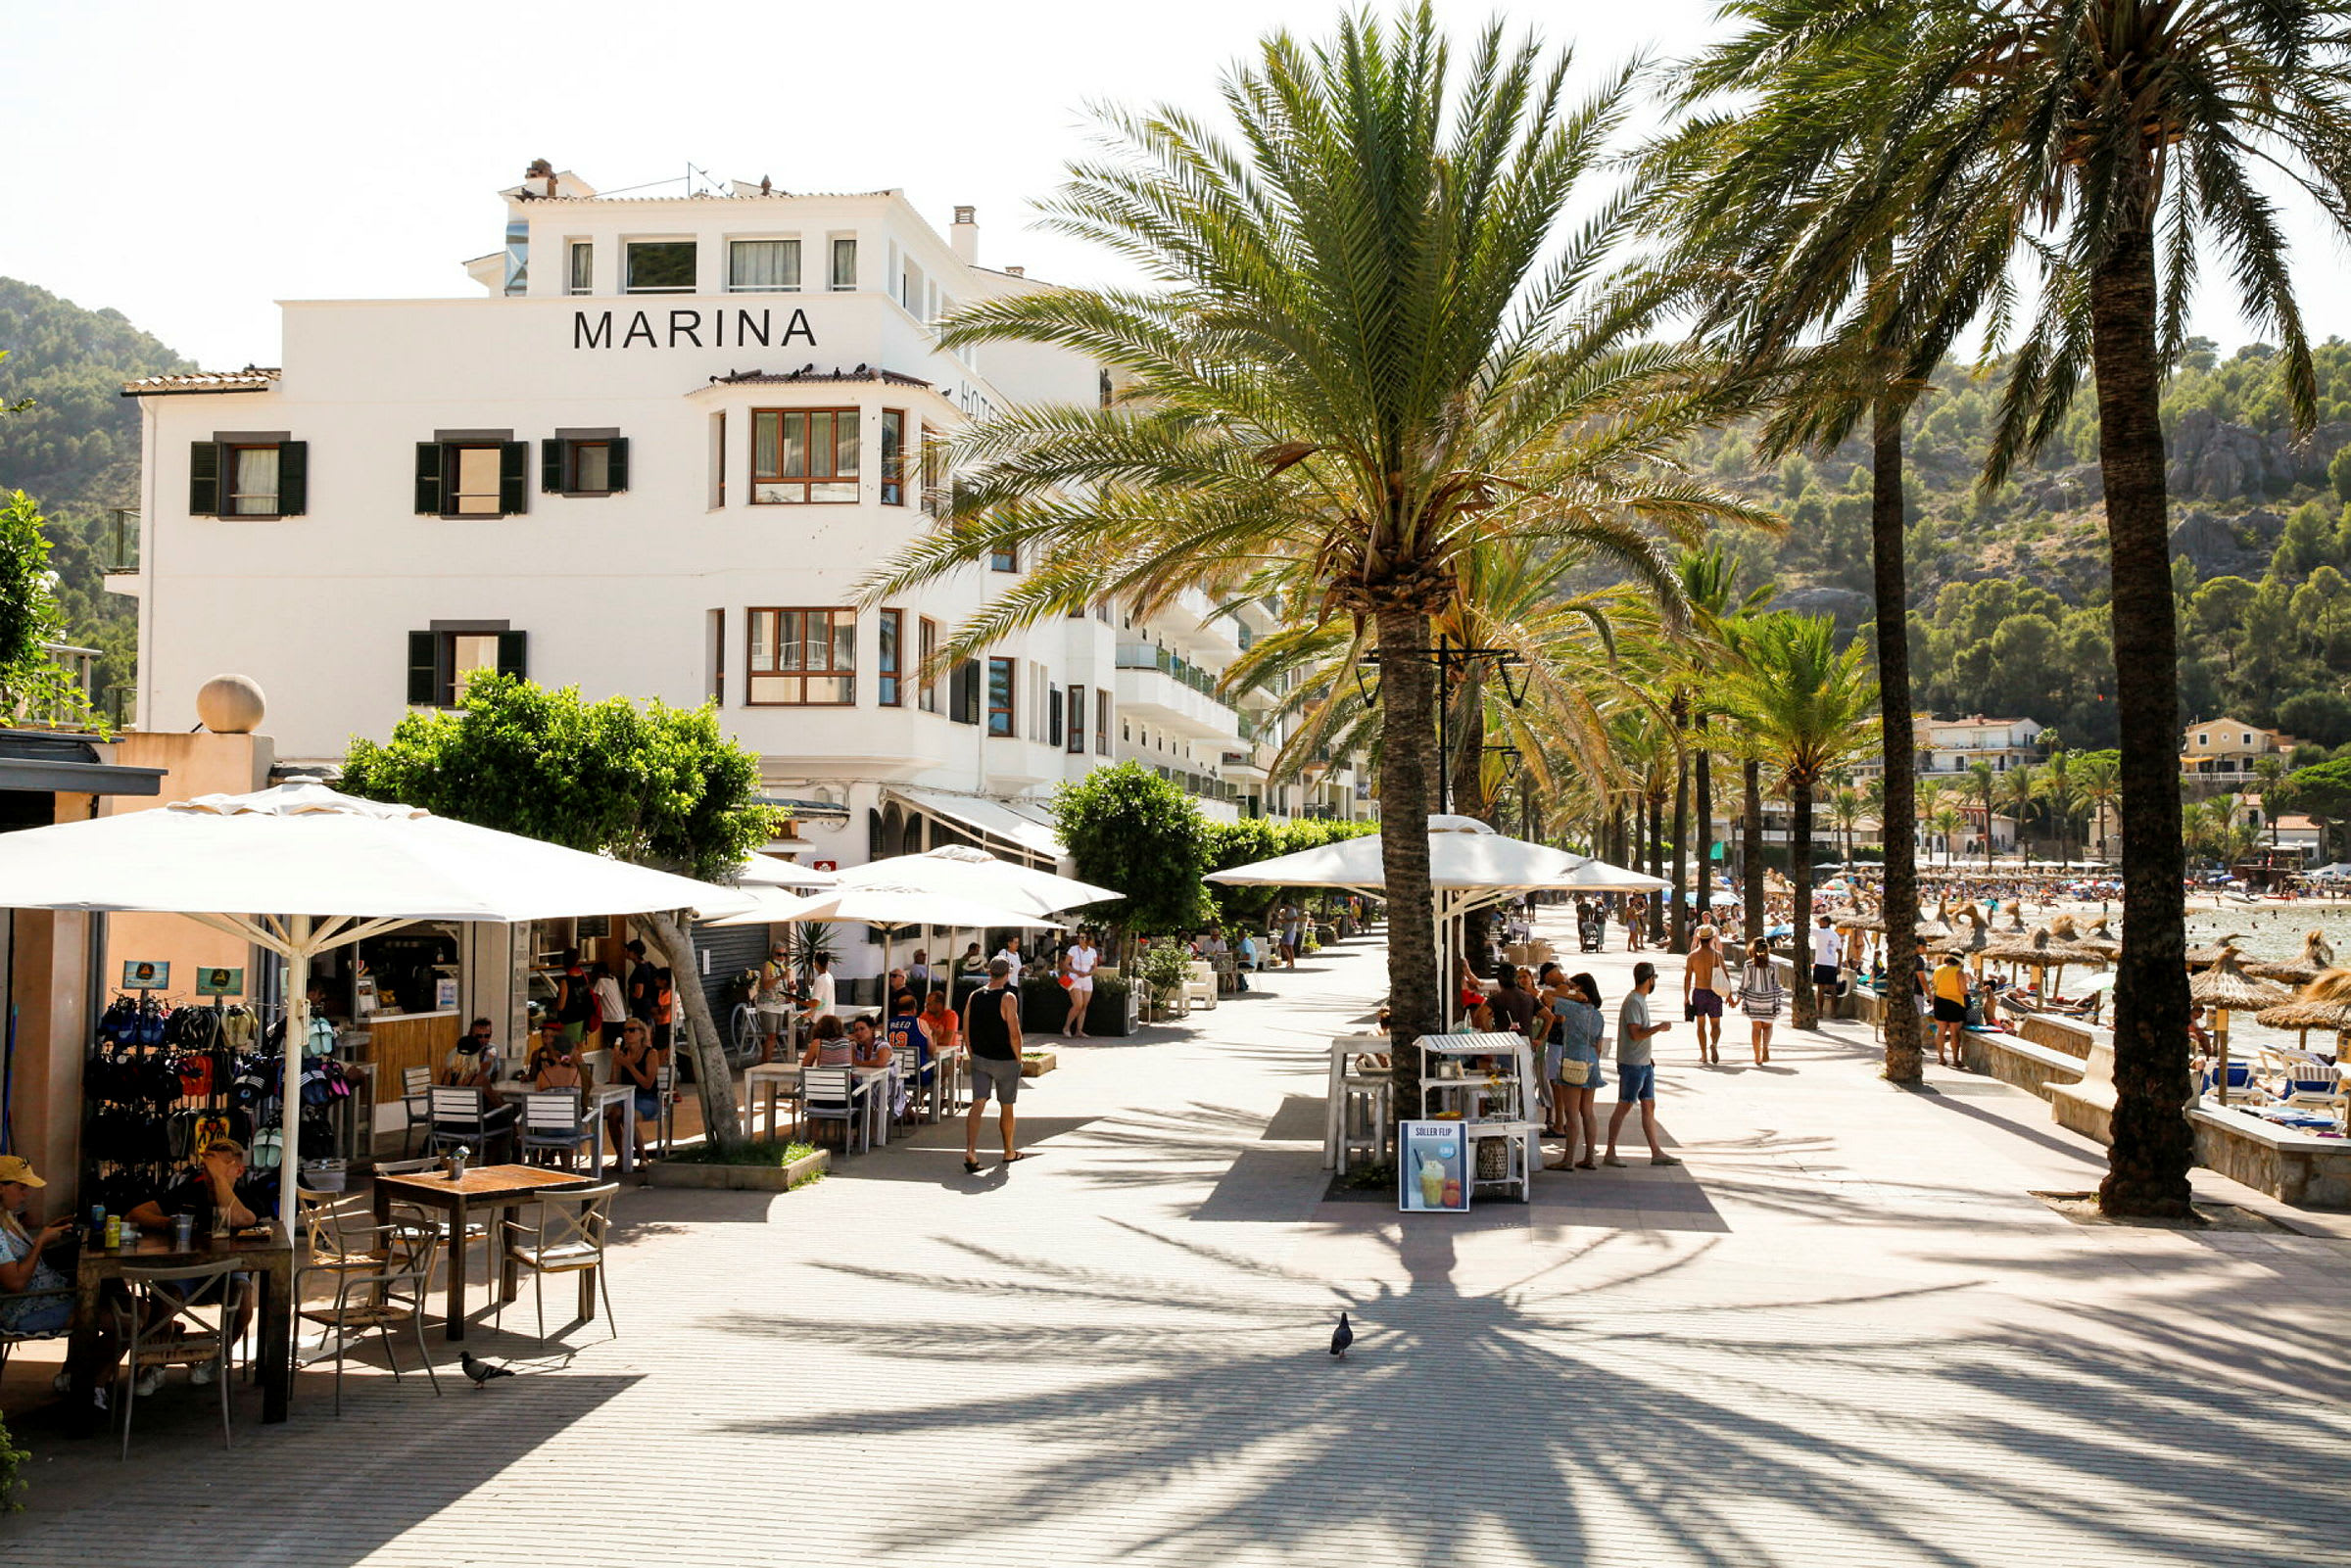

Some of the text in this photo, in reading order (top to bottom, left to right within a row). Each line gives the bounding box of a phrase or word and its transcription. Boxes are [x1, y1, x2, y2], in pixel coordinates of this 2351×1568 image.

[574, 309, 817, 349] MARINA
[961, 380, 999, 424] HOTE
[888, 1031, 908, 1047] 19
[1439, 1127, 1453, 1136] FLIP
